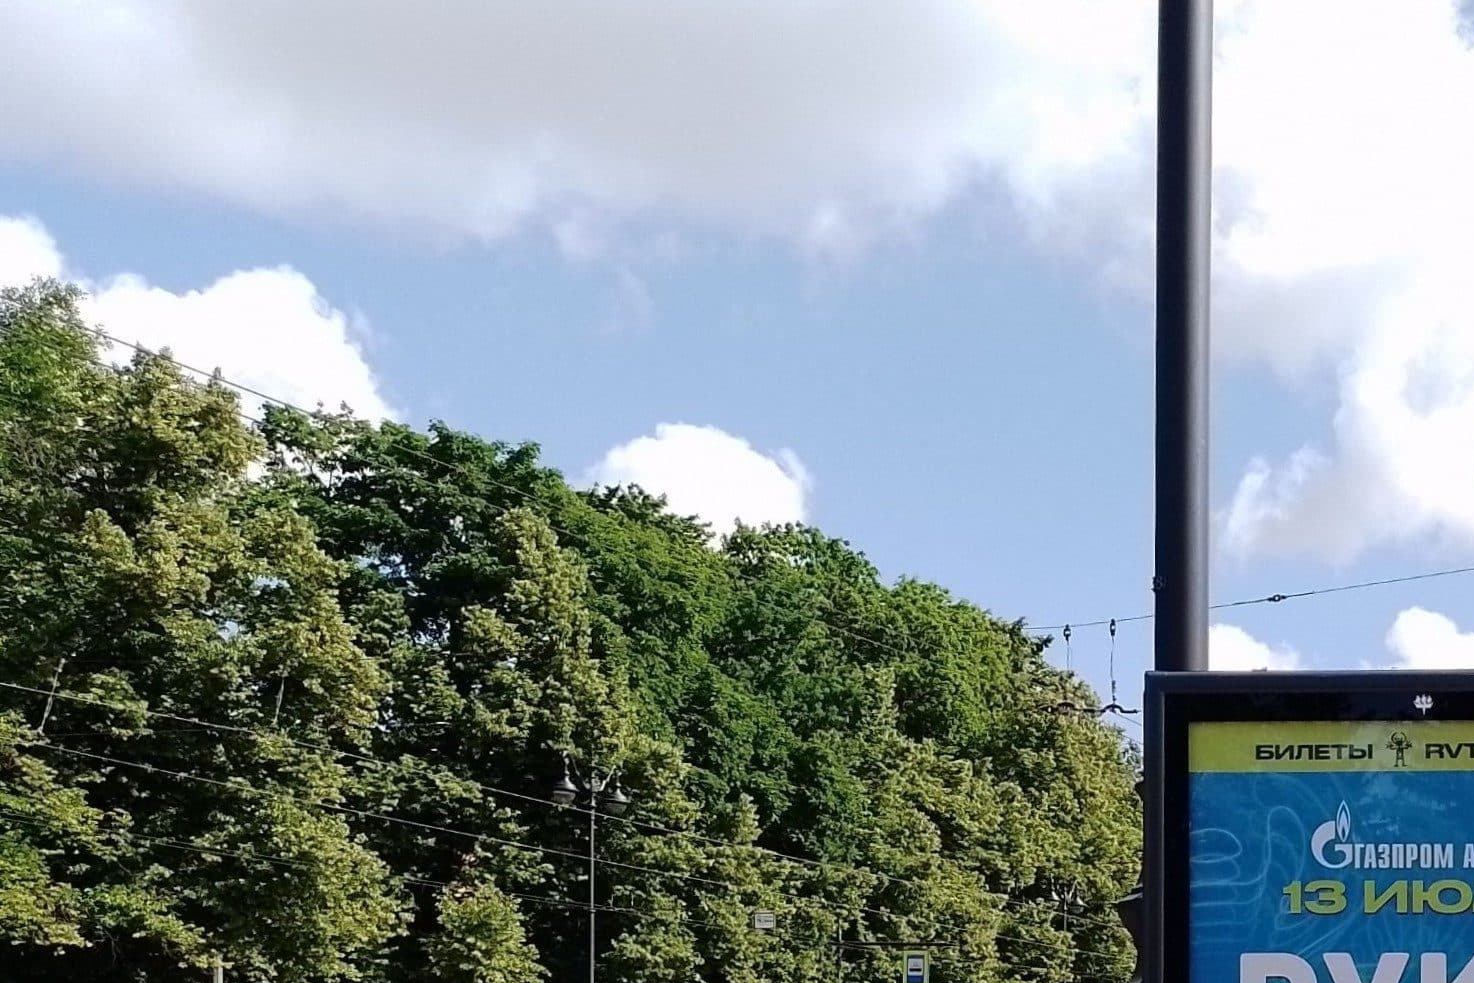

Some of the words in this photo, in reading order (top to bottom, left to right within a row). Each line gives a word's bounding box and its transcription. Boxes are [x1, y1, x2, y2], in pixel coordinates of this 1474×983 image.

[1255, 744, 1373, 760] БИЛЕТЫ
[1354, 843, 1453, 869] ГАЗПРОМ
[1283, 880, 1347, 914] 13
